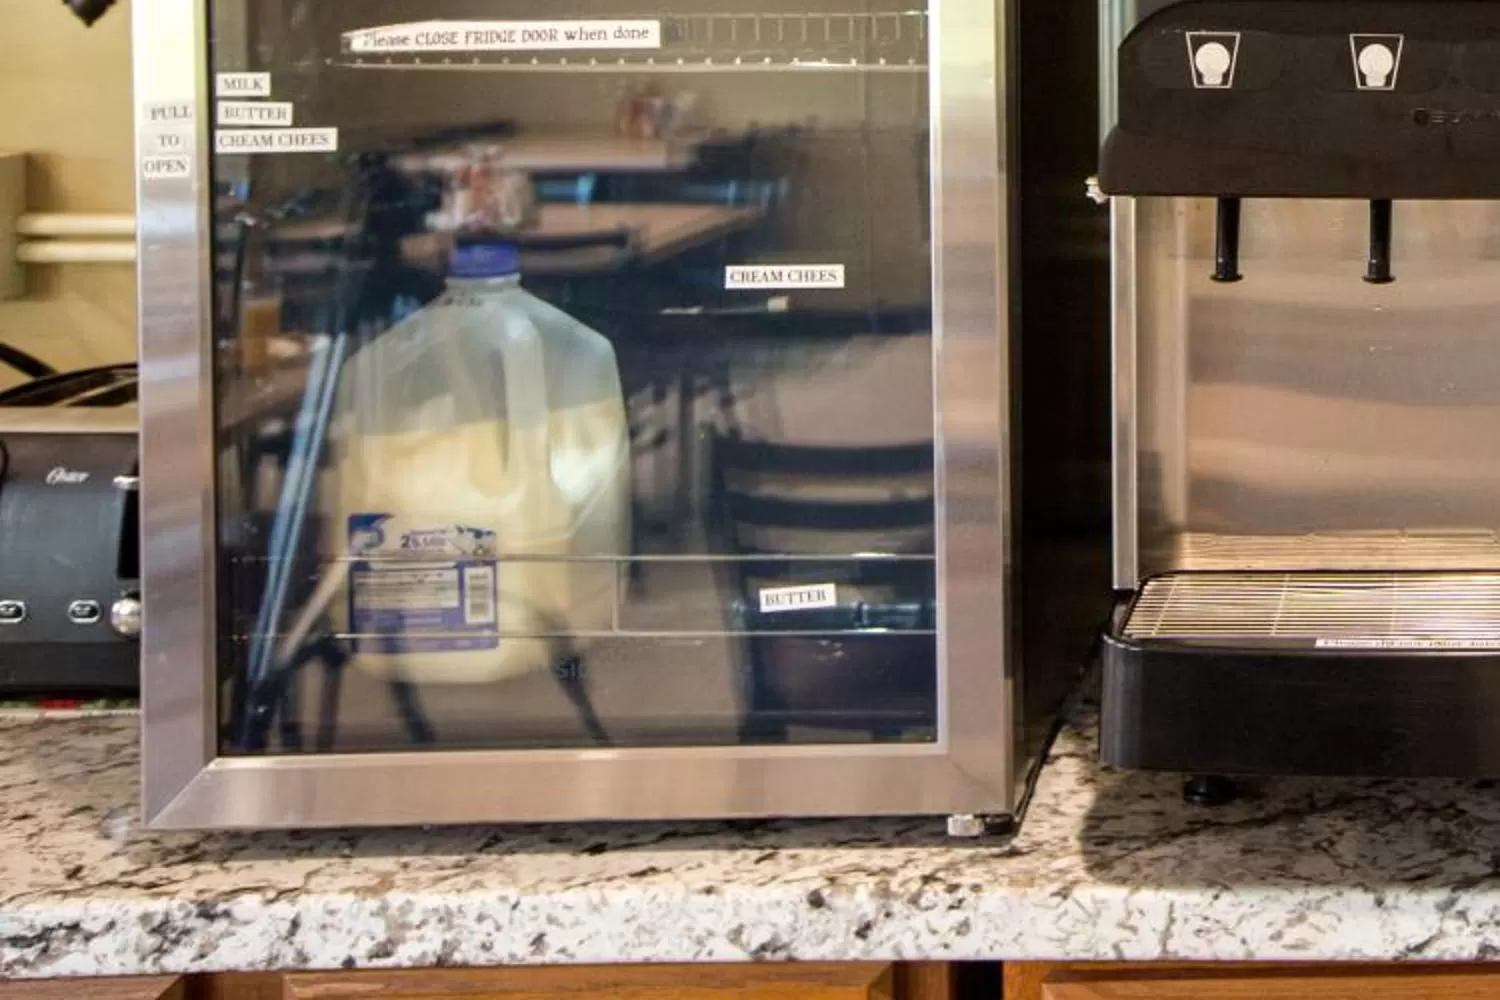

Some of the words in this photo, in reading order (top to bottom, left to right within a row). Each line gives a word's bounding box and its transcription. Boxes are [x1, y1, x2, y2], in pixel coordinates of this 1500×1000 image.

[363, 30, 411, 47] Please
[414, 31, 460, 47] CLOSE
[463, 29, 518, 45] FRIDGE
[520, 28, 560, 43] DOOR
[563, 26, 607, 41] when
[612, 25, 650, 40] done
[223, 77, 264, 91] MILK
[150, 106, 193, 121] PULL
[224, 106, 287, 121] BUTTER
[159, 133, 180, 147] TO
[218, 135, 274, 147] CREAM
[277, 133, 329, 146] CHEES
[144, 159, 187, 173] OPEN
[729, 271, 783, 283] CREAM
[787, 269, 838, 282] CHEES
[765, 589, 827, 606] BUTTER
